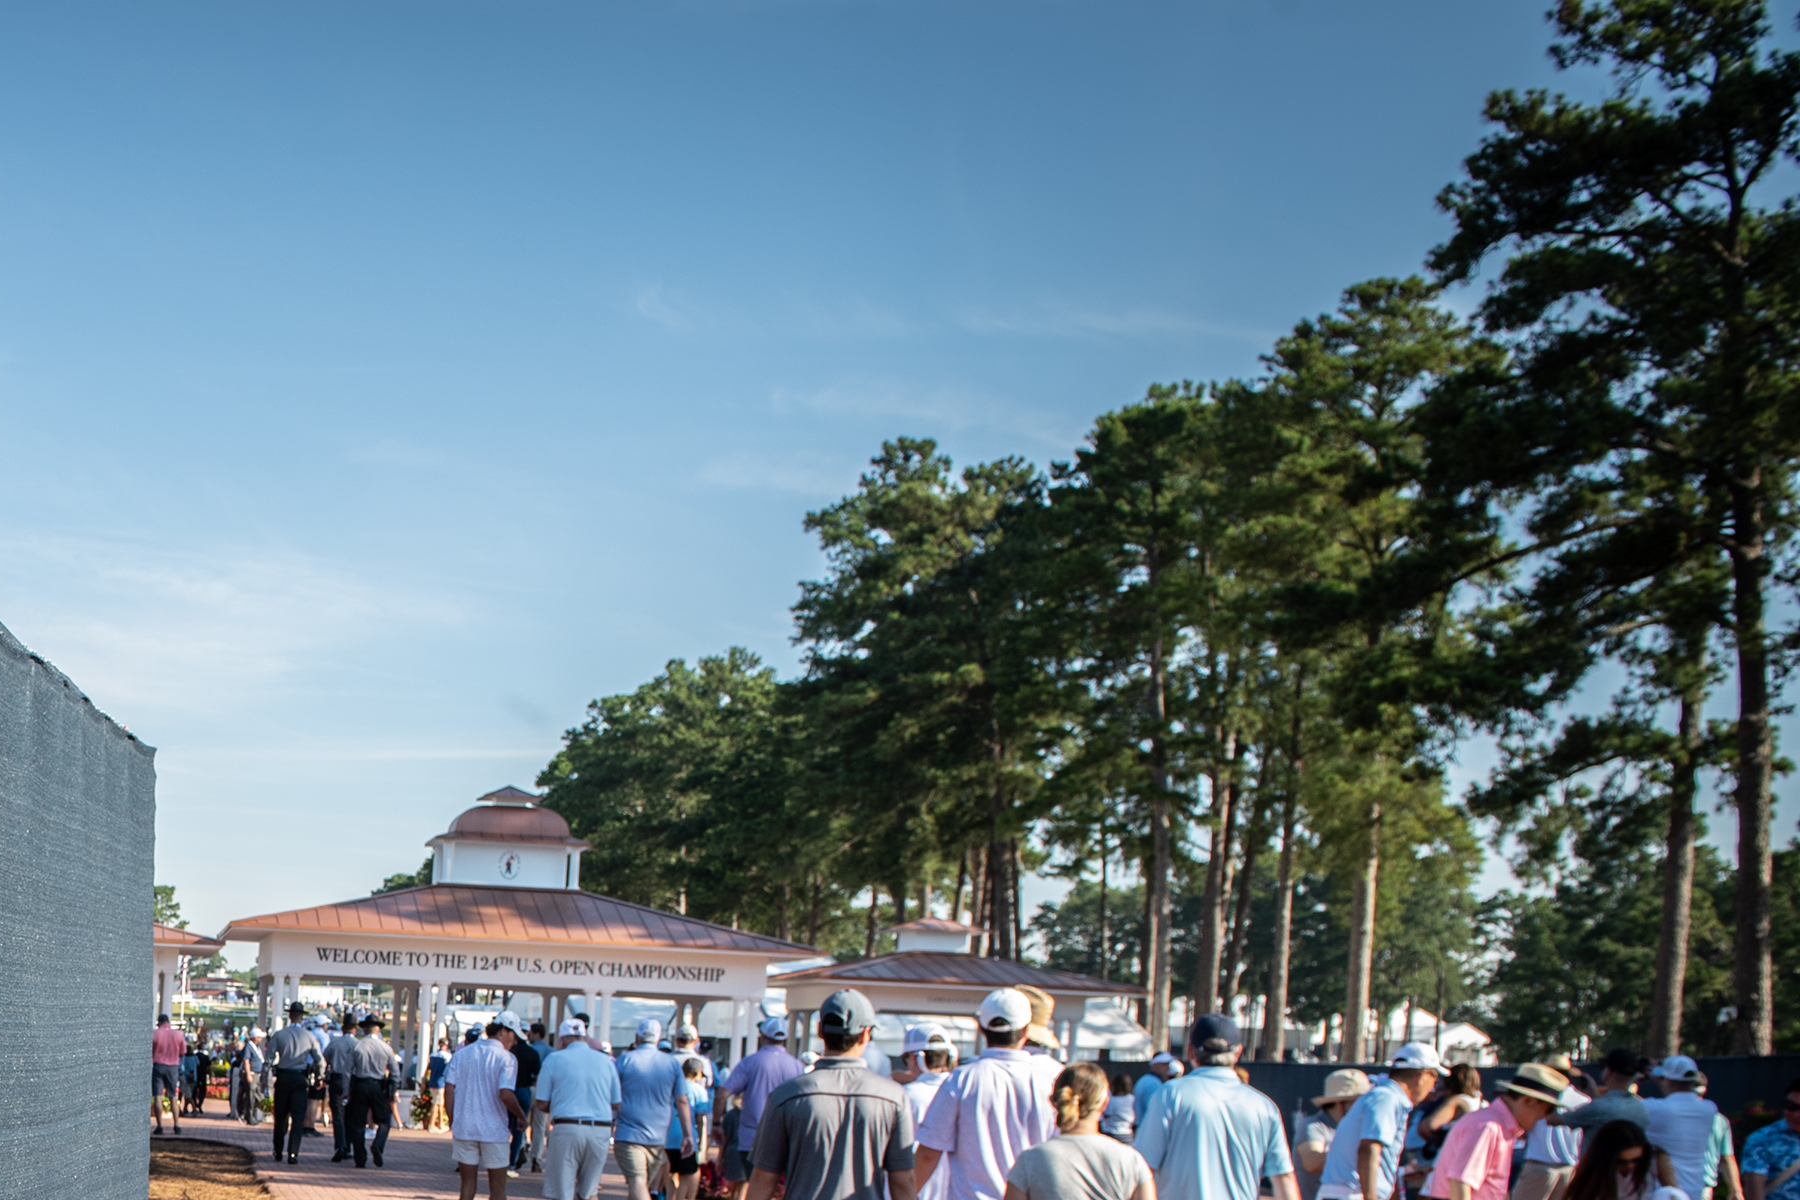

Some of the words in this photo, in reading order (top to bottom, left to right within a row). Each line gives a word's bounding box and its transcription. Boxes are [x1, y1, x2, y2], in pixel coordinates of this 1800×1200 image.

[316, 947, 402, 966] WELCOME
[406, 951, 429, 967] TO
[433, 952, 467, 969] THE
[516, 957, 545, 973] U.S.
[550, 959, 595, 976] OPEN
[599, 961, 726, 982] CHAMPIONSHIP
